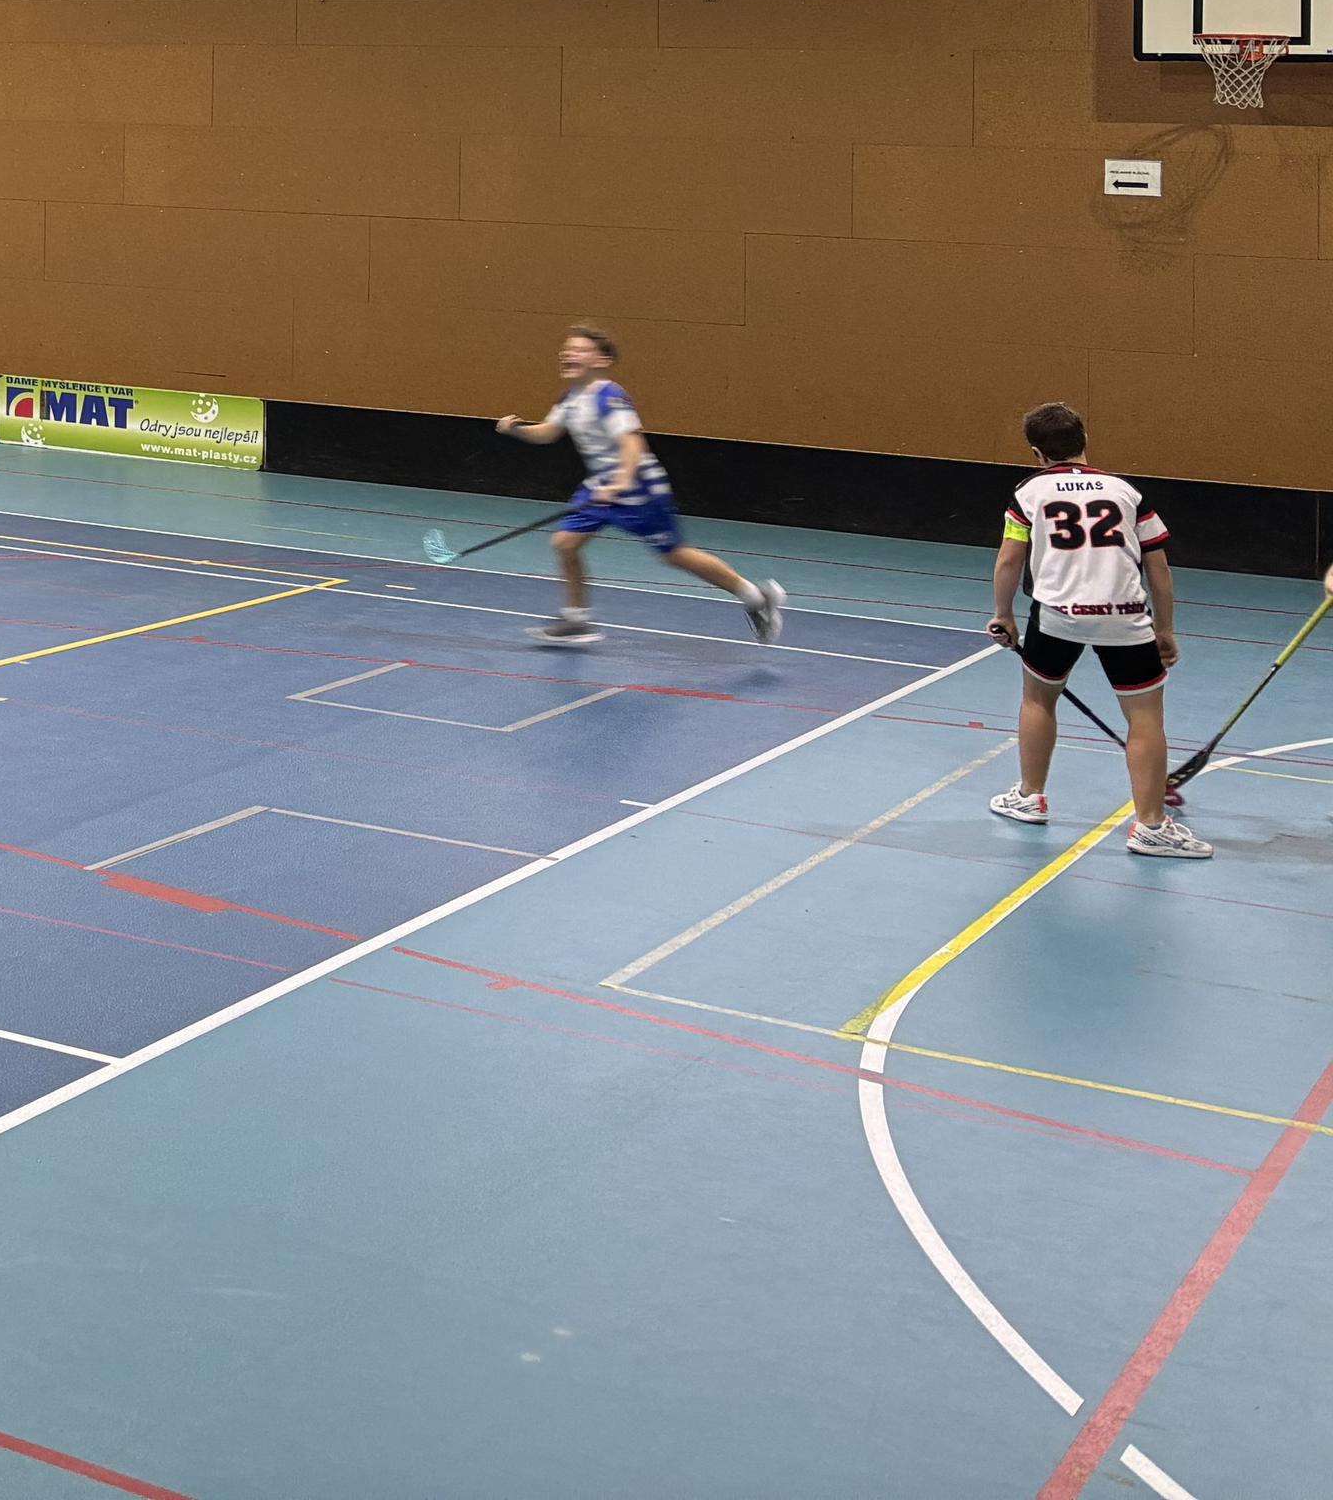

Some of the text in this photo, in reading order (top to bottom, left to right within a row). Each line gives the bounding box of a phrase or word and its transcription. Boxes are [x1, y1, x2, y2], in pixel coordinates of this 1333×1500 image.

[102, 386, 134, 397] TVAR
[40, 389, 134, 429] MAT
[139, 418, 259, 447] Odry jsou nejlepší!
[141, 443, 258, 465] www.mat-plasty.cz
[1043, 499, 1126, 550] 32
